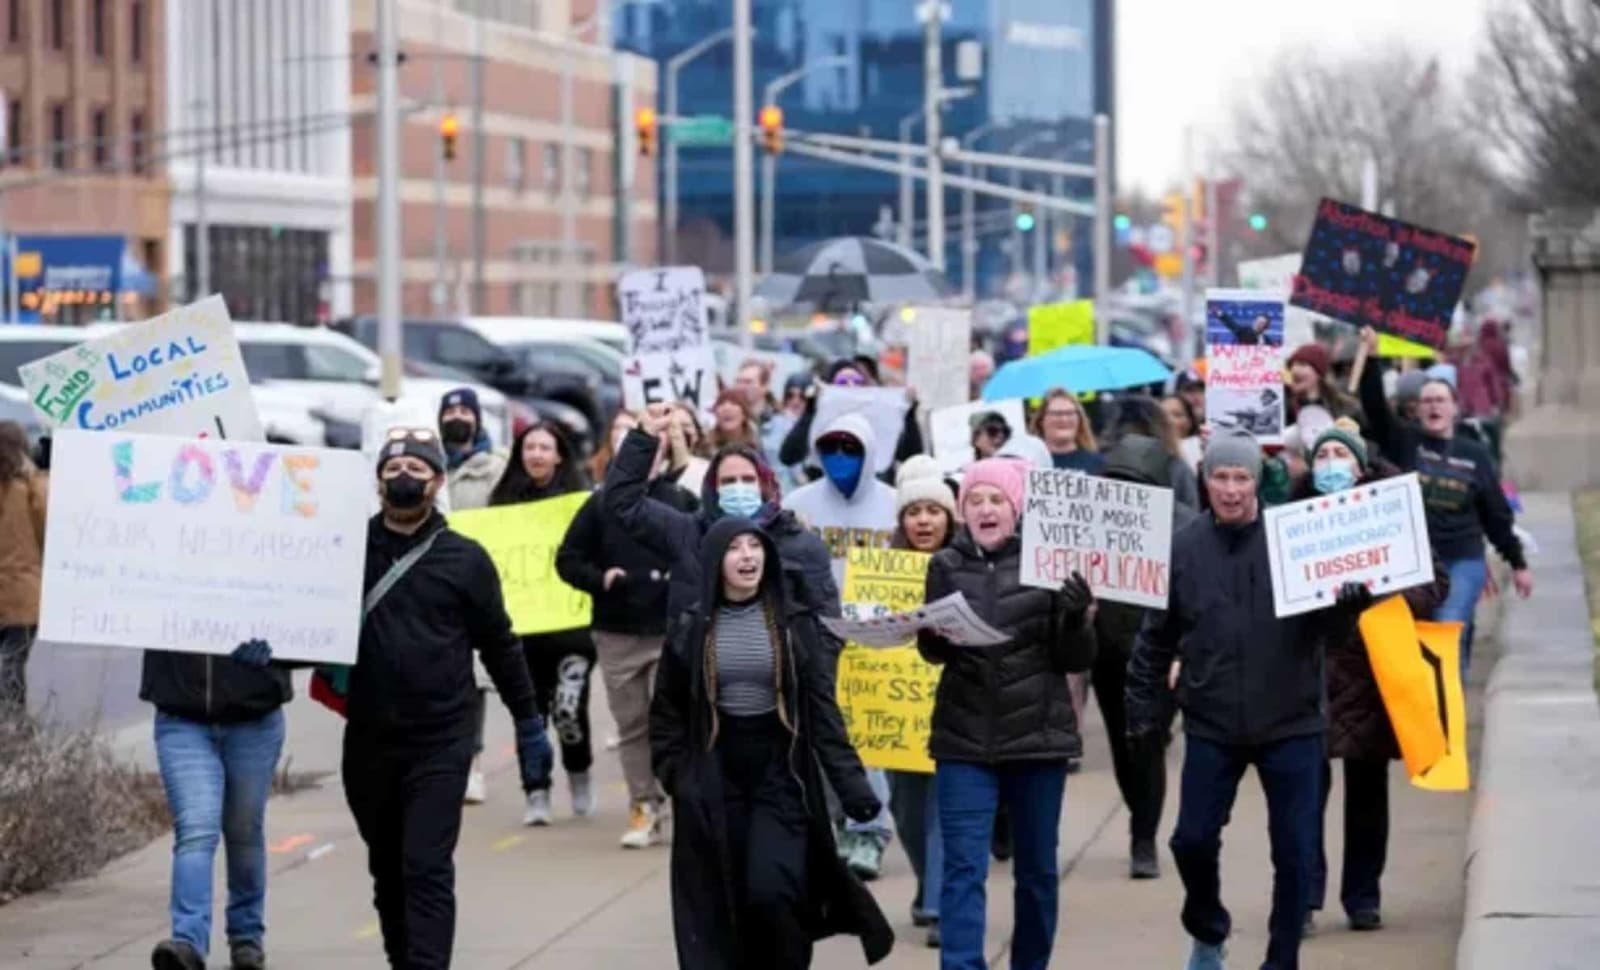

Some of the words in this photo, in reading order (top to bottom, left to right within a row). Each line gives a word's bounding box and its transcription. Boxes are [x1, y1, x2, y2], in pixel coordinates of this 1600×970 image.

[655, 272, 667, 291] I
[107, 336, 207, 380] LOCAL
[34, 369, 91, 419] FUND
[77, 372, 230, 431] COMMUNITIES
[112, 440, 321, 518] LOVE
[1029, 470, 1090, 499] REPEAT
[1094, 480, 1149, 509] AFTER
[1027, 498, 1063, 517] ME:
[1068, 502, 1094, 523] NO
[1102, 510, 1153, 531] MORE
[1328, 505, 1369, 528] FEAR
[1039, 522, 1096, 548] VOTES
[1106, 530, 1144, 552] FOR
[850, 548, 928, 575] UNDOCU
[1034, 545, 1169, 597] REPUBLICANS
[1303, 563, 1312, 582] I
[1315, 544, 1391, 580] DISSENT
[888, 677, 924, 702] SS
